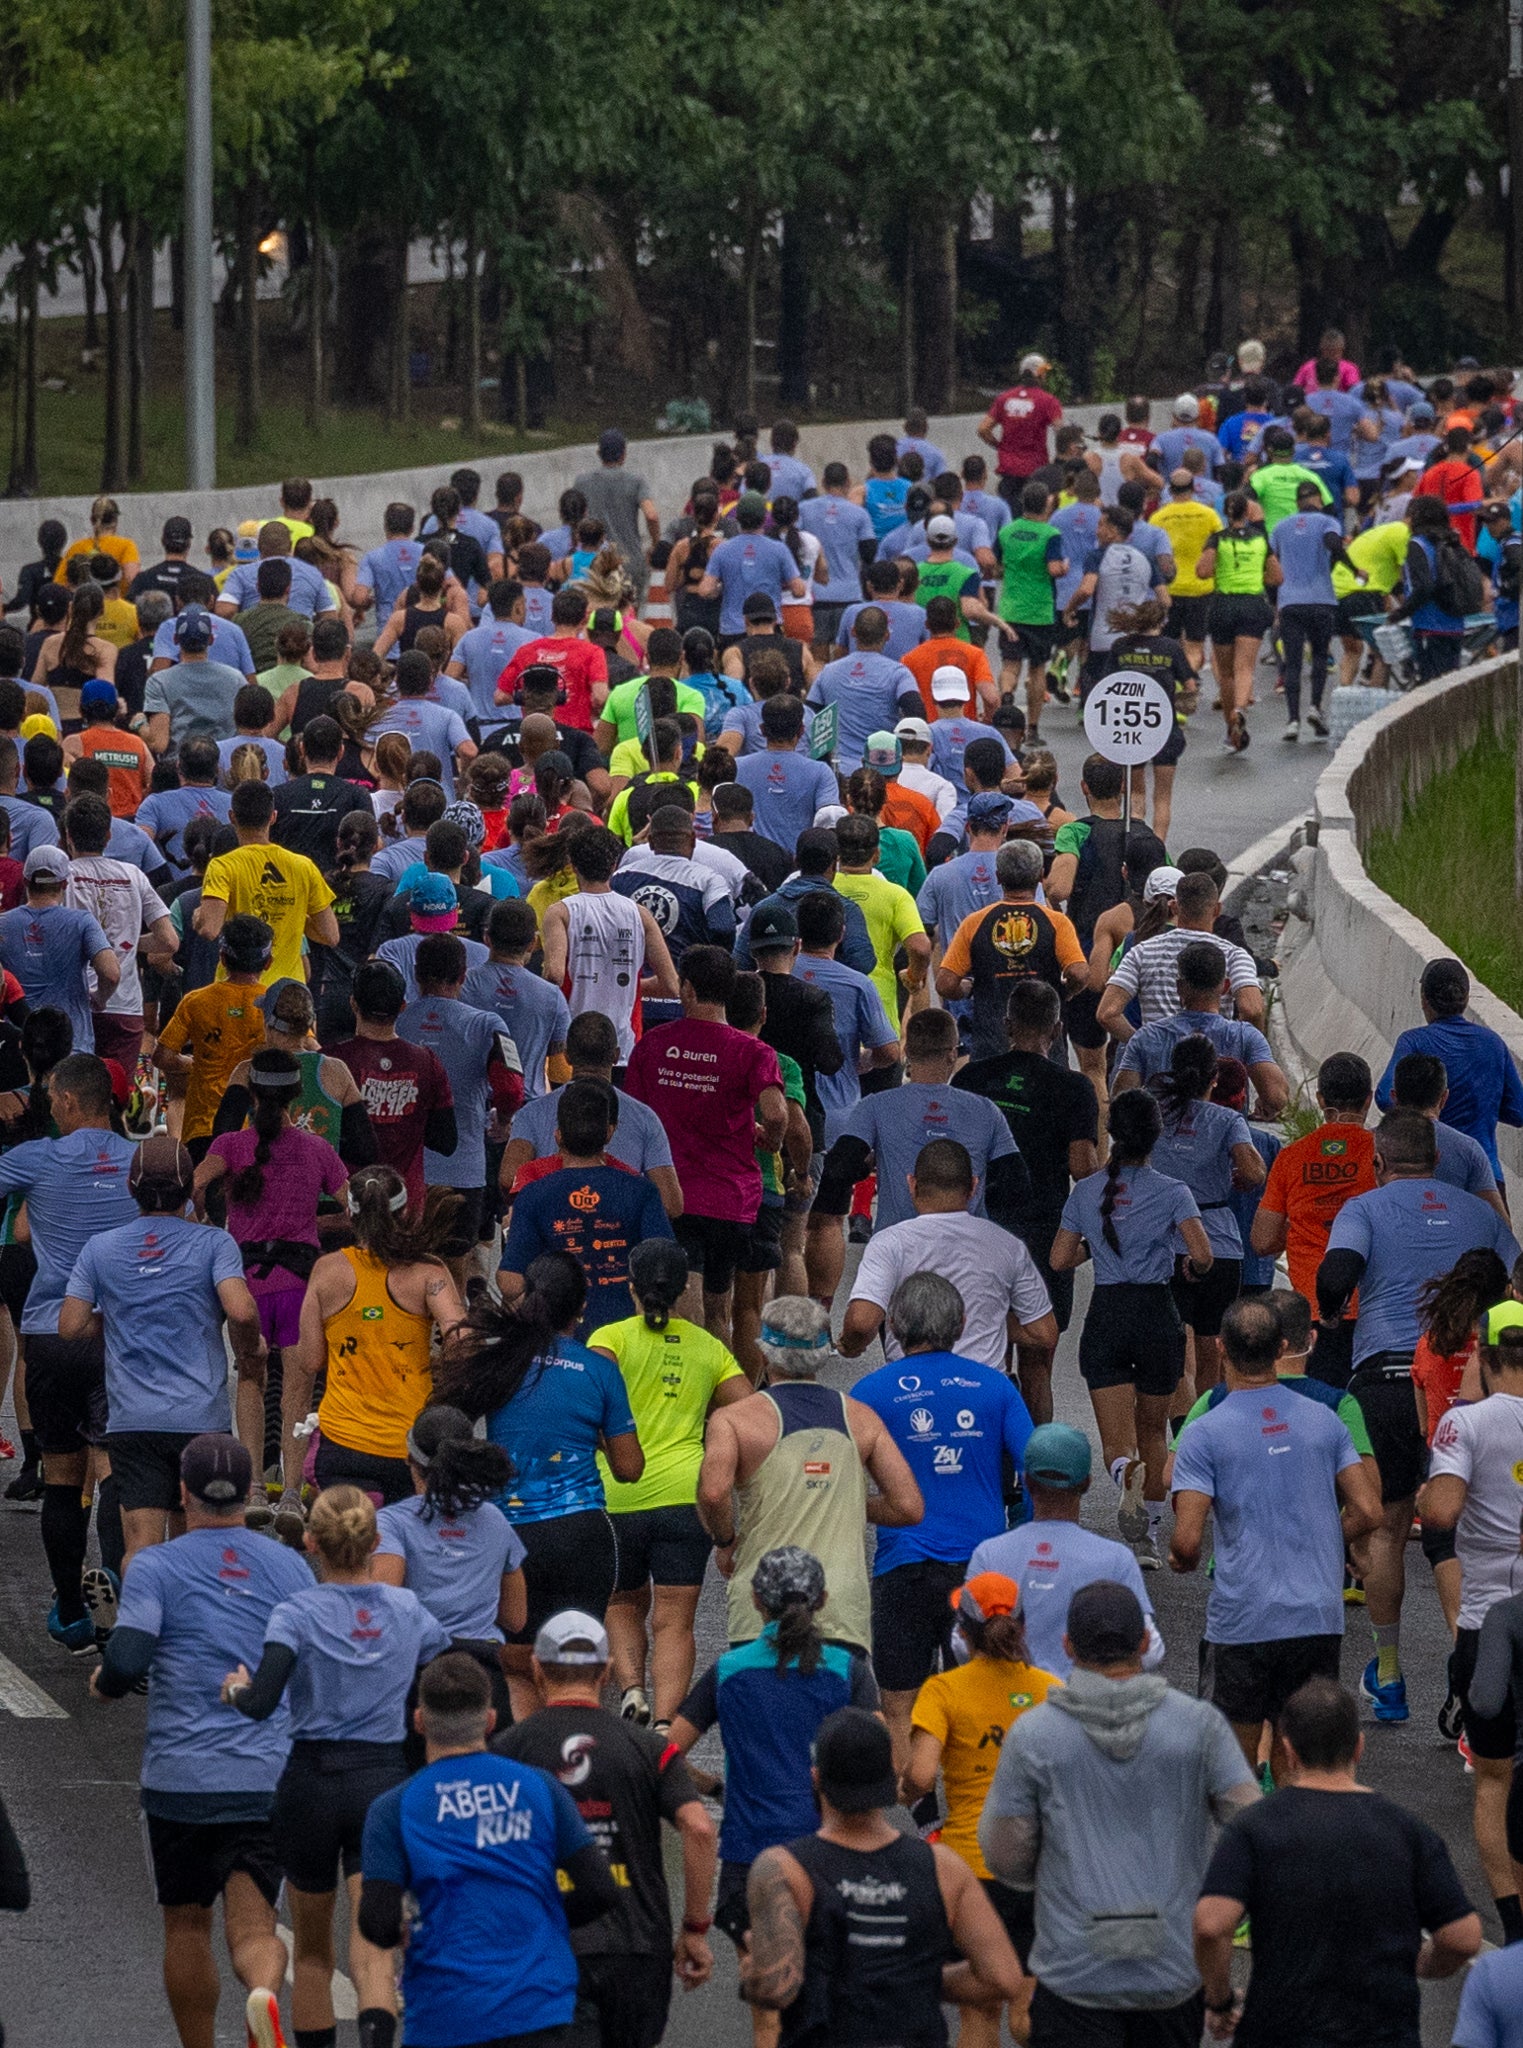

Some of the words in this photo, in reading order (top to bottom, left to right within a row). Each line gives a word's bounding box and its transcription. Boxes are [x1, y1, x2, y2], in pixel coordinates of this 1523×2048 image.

[1105, 682, 1146, 697] AZON
[1094, 700, 1162, 728] 1:55
[1113, 731, 1143, 745] 21K
[682, 1049, 718, 1064] auren
[657, 1077, 669, 1086] da
[682, 1072, 720, 1084] potencial
[361, 1084, 419, 1104] LONGER
[436, 1780, 521, 1823] ABELV
[476, 1808, 533, 1850] RUN
